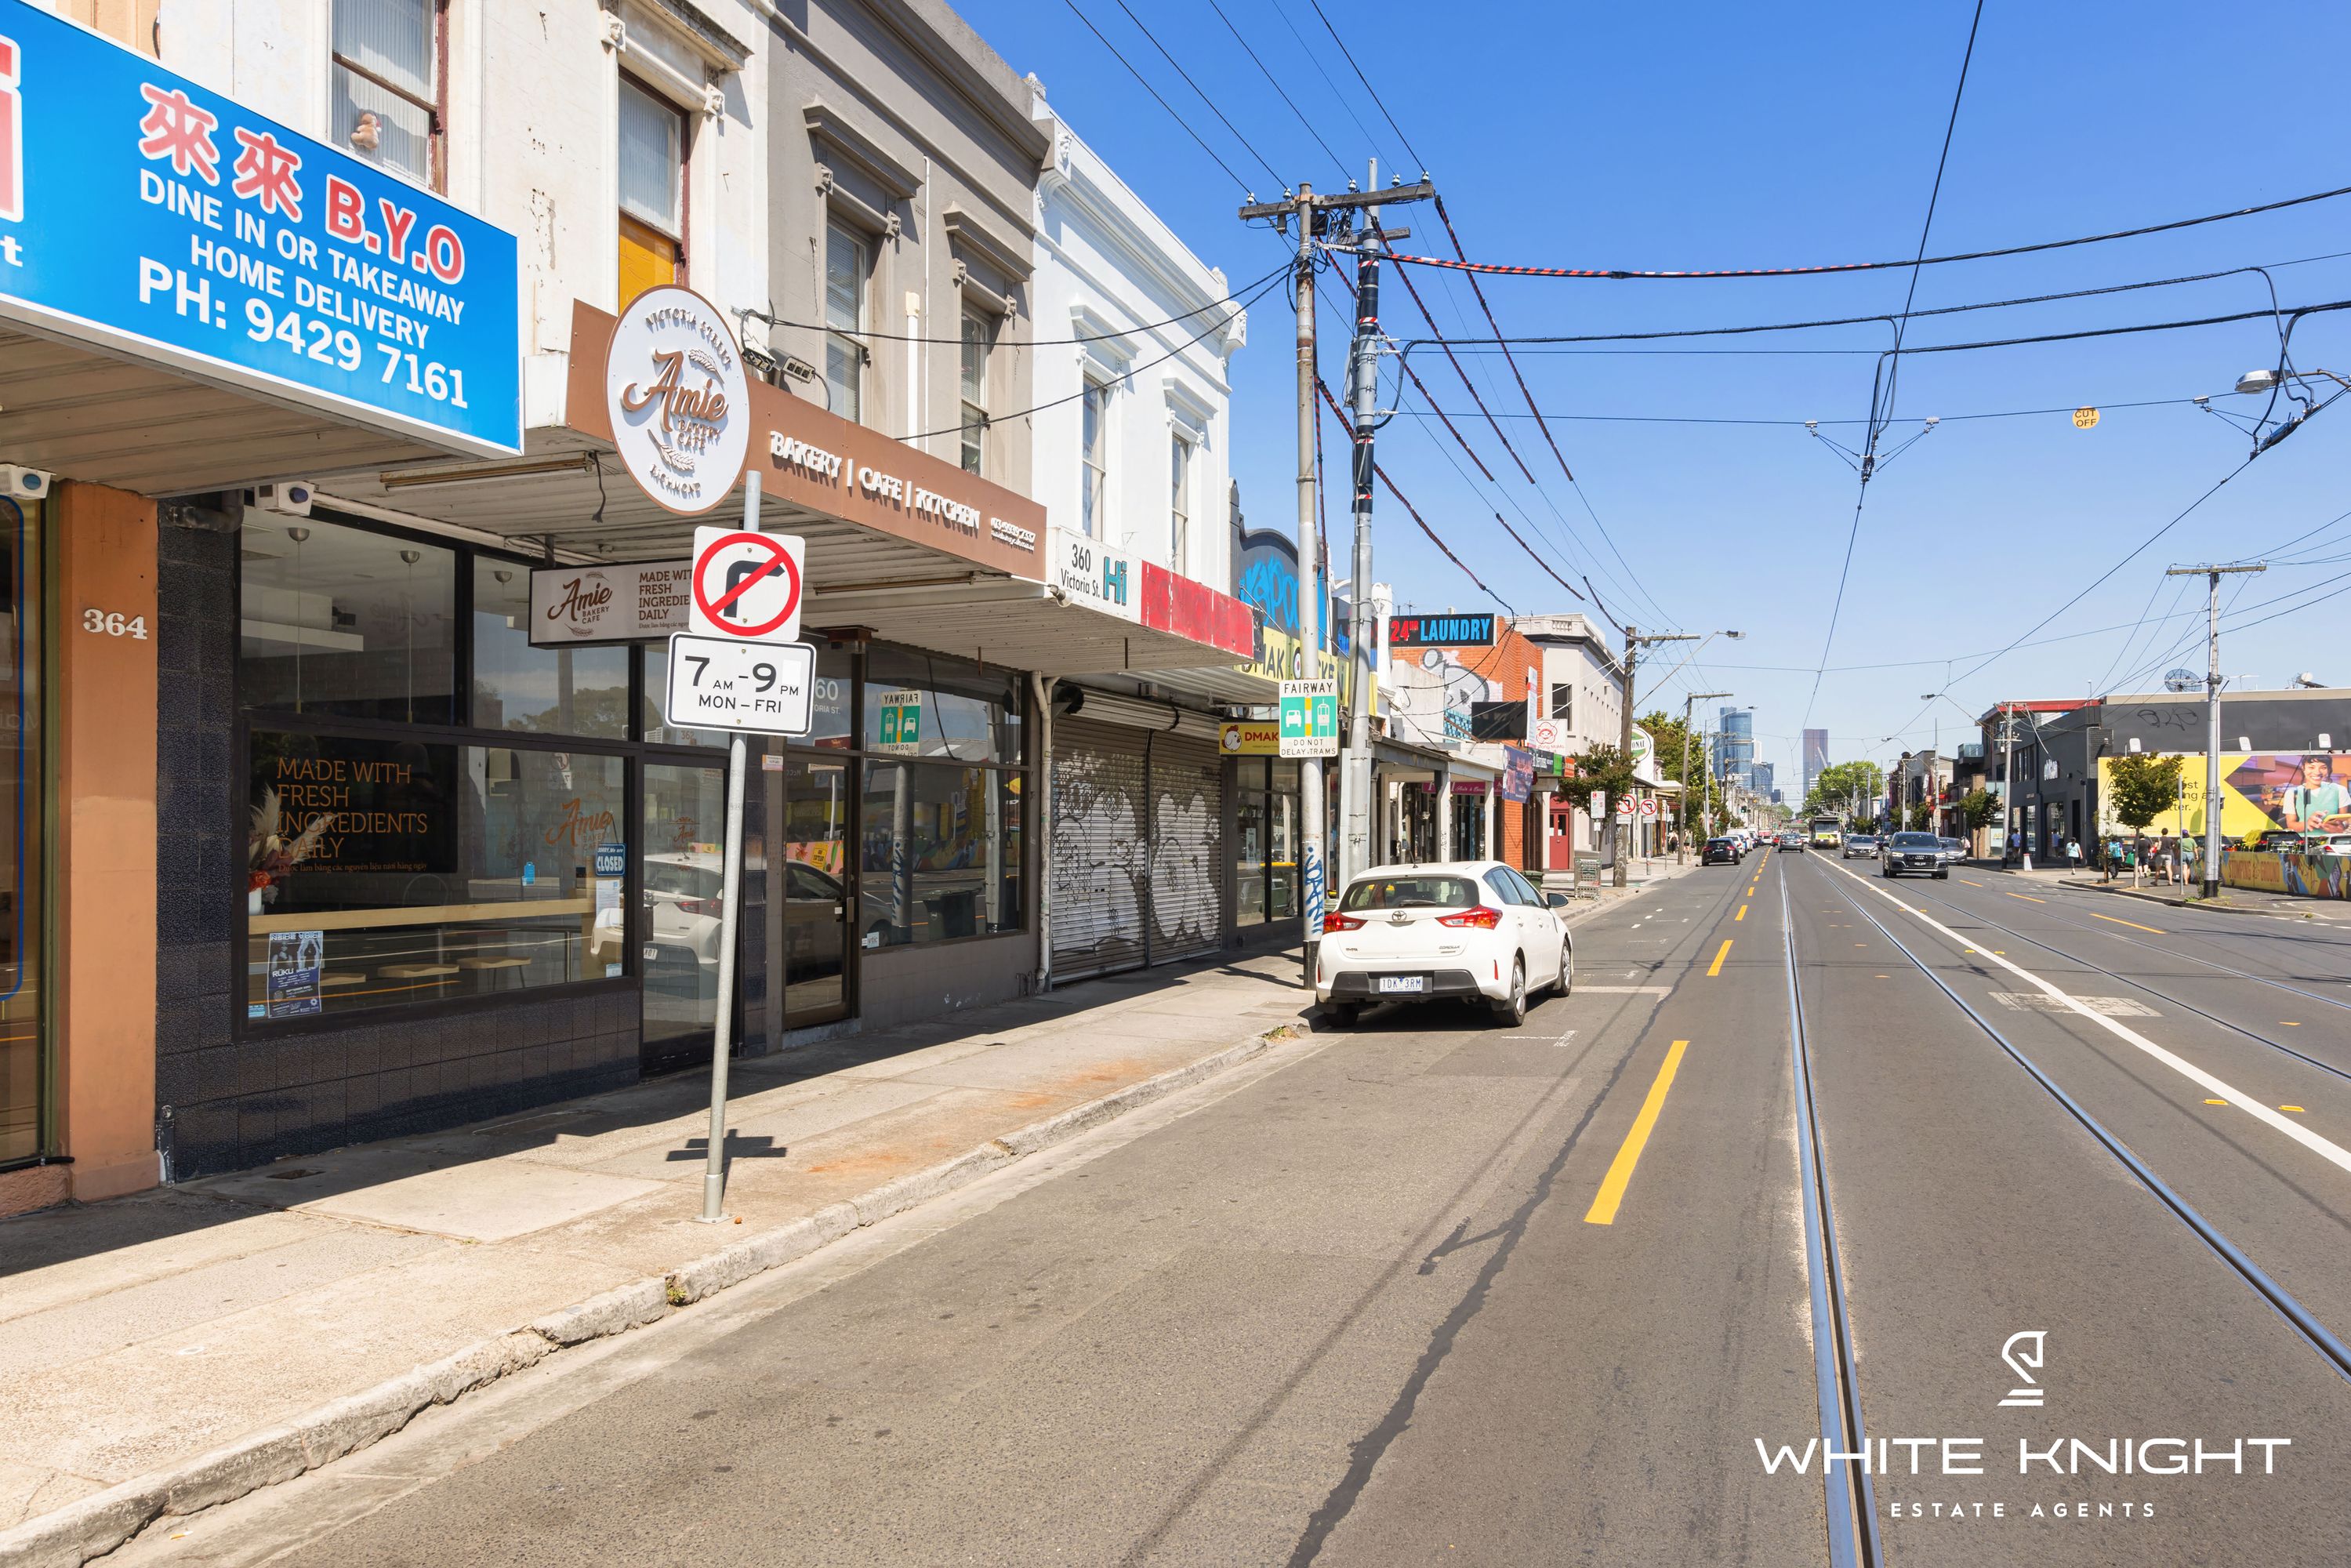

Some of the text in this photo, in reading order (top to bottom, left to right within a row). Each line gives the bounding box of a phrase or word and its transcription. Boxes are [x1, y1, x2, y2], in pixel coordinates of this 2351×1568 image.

[325, 173, 466, 285] B.Y.O
[140, 168, 466, 327] DINE IN OR TAKEAWAY
[191, 234, 430, 350] HOME DELIVERY
[140, 256, 468, 409] PH: 9429 7161
[645, 308, 732, 365] VICTORIA STREET
[621, 347, 730, 433] Amie
[2075, 408, 2095, 418] CUT
[677, 419, 721, 440] BAKERY
[677, 433, 706, 449] CAFE
[649, 463, 702, 493] RICHMOND
[770, 430, 842, 479] BAKERY
[858, 466, 902, 501] CAFE
[916, 487, 981, 529] KITCHEN
[1072, 543, 1091, 572] 360
[639, 571, 670, 583] MADE
[1061, 568, 1090, 594] Victoria
[1103, 556, 1127, 606] Hi
[547, 578, 613, 622] Amie
[639, 583, 673, 596] FRESH
[582, 606, 610, 617] BAKERY
[639, 595, 690, 608] INGREDIE
[83, 608, 148, 640] 364
[582, 615, 601, 624] CAFE
[639, 608, 669, 620] DAILY
[1420, 619, 1490, 641] LAUNDRY
[685, 655, 710, 687] 7
[713, 680, 733, 691] AM
[780, 685, 799, 696] PM
[815, 679, 839, 701] 60
[1284, 682, 1333, 694] FAIRWAY
[681, 731, 694, 740] 362
[1245, 731, 1279, 742] DMAK
[278, 757, 412, 783] MADE WITH
[278, 784, 350, 807] FRESH
[278, 811, 428, 833] INGREDIENTS
[545, 797, 615, 847] Amie
[278, 837, 345, 858] DAILY
[597, 856, 623, 872] CLOSED
